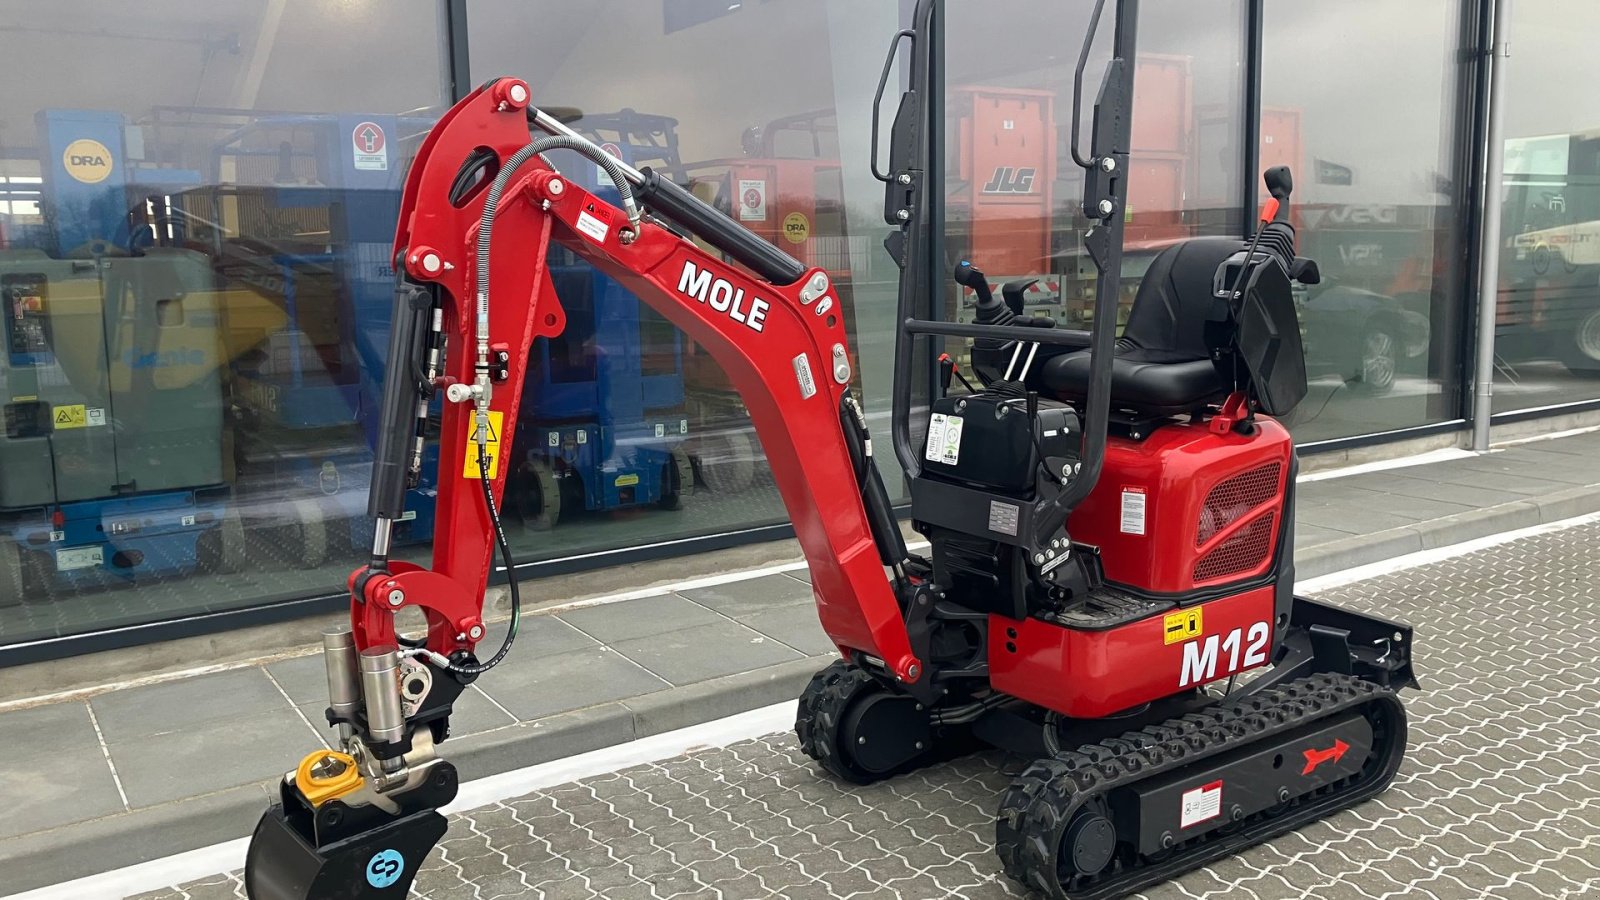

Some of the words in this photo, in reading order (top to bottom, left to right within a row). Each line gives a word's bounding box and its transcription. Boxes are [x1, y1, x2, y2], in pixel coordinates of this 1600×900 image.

[71, 155, 105, 166] DRA
[983, 167, 1036, 193] JLG
[786, 223, 806, 233] DRA
[677, 259, 770, 333] MOLE
[1179, 621, 1269, 688] M12
